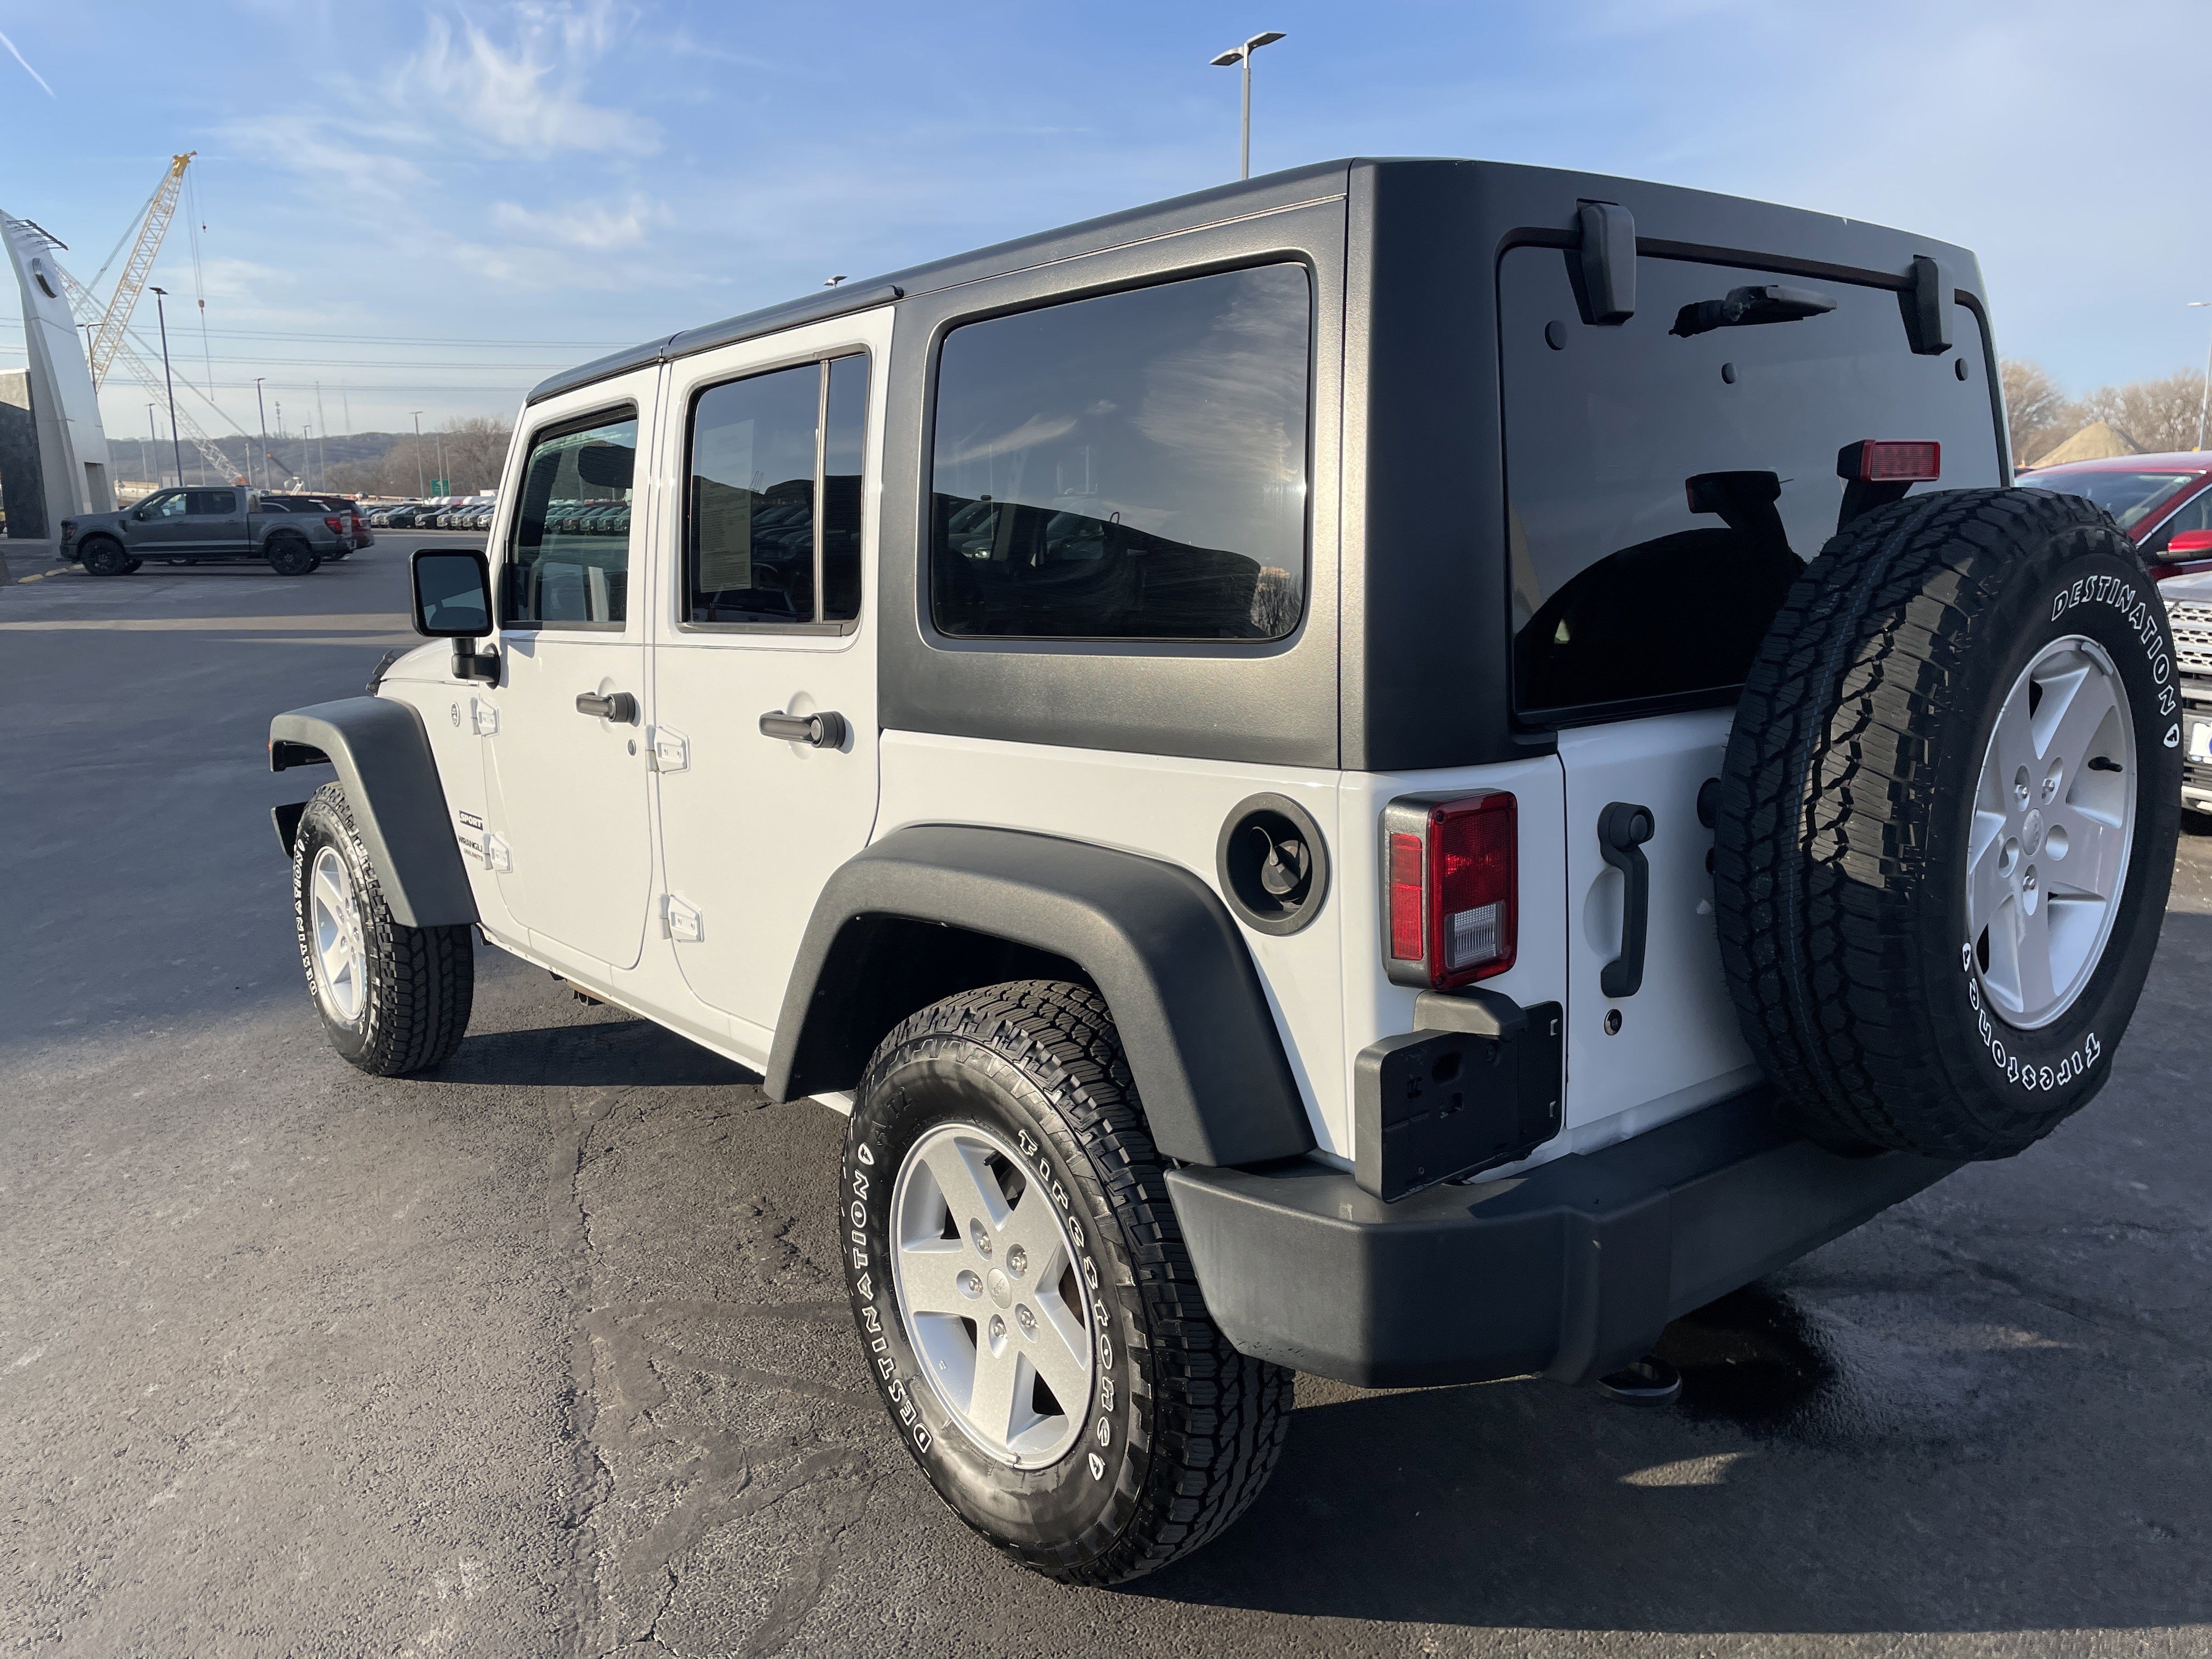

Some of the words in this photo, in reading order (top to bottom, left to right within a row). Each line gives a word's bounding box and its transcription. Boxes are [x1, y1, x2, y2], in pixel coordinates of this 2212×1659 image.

[2051, 575, 2176, 716] DESTINATION
[458, 834, 483, 853] WRANGL
[460, 812, 483, 828] SPORT
[464, 848, 483, 862] UNLIMITE
[294, 851, 318, 996] DESTINATION
[851, 1169, 932, 1453] DESTINATION
